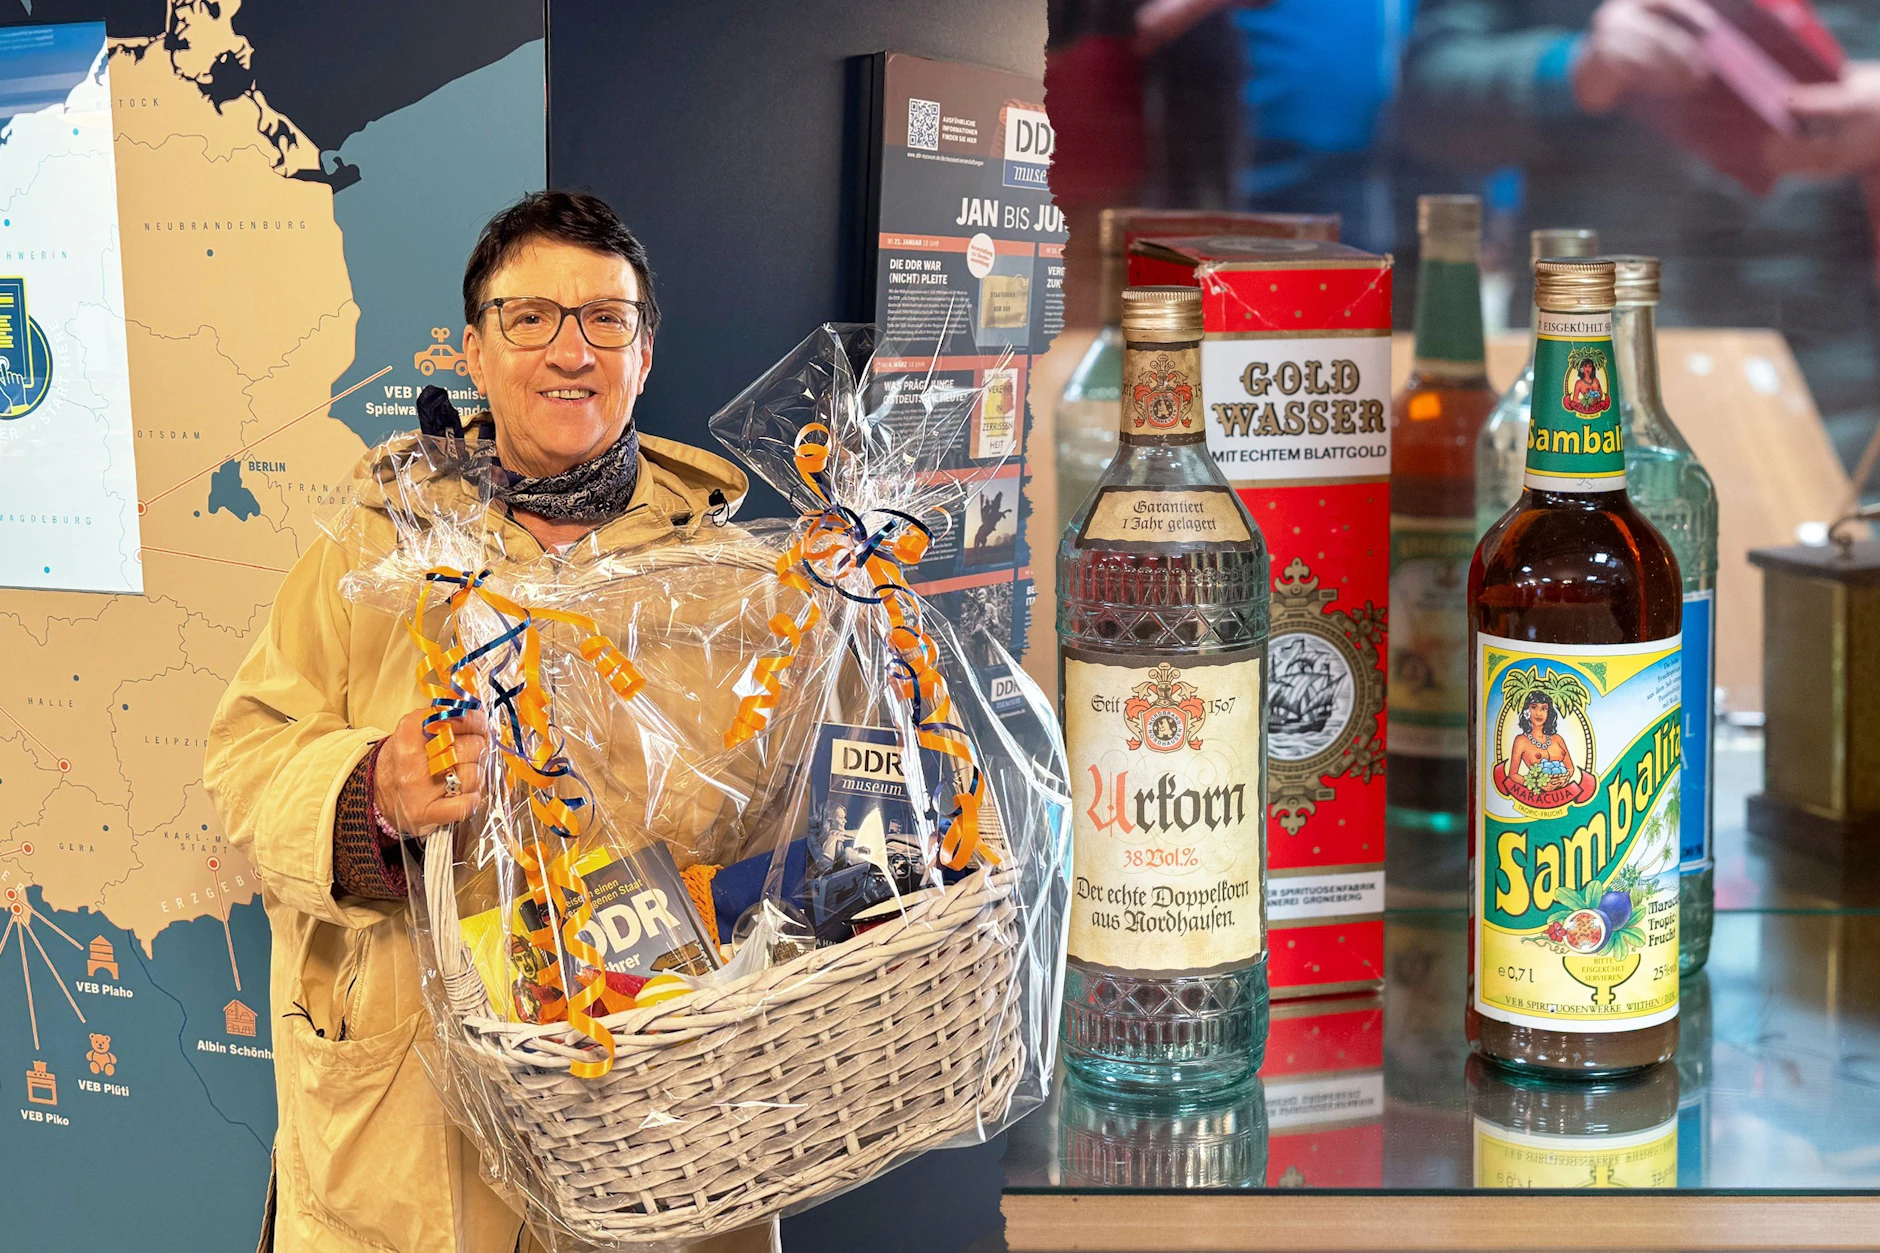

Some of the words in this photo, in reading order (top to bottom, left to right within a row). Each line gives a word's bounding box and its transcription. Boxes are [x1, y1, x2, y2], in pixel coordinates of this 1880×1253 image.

[955, 197, 999, 228] JAN
[1004, 205, 1030, 230] BIS
[144, 221, 306, 231] NEUBRANDENBURG
[889, 258, 904, 270] DIE
[905, 259, 922, 271] DDR
[923, 260, 942, 271] WAR
[889, 272, 920, 285] (NICHT)
[921, 273, 948, 285] PLEITE
[1543, 321, 1604, 333] EISGEKÜHLT
[903, 378, 926, 391] PRÄG
[1240, 359, 1361, 396] GOLD
[383, 385, 413, 399] VEB
[365, 401, 418, 418] Spielwa
[1210, 399, 1387, 438] WASSER
[1211, 450, 1239, 463] MIT
[1240, 448, 1301, 462] ECHTEM
[1304, 445, 1387, 461] BLATTGOLD
[249, 461, 286, 473] BERLIN
[1132, 500, 1204, 516] Garantiert
[1130, 516, 1164, 532] Jahr
[1167, 516, 1217, 533] gelagert
[28, 697, 73, 708] HALLE
[1091, 694, 1121, 714] Seit
[1208, 696, 1237, 716] 1507
[1148, 711, 1182, 727] NORDBRAND
[1148, 727, 1183, 747] NORDHAUSEN
[843, 746, 905, 777] DDR
[841, 778, 906, 797] museum
[1510, 784, 1574, 804] MARACUJA
[1086, 763, 1247, 838] Urkorn
[164, 831, 230, 844] KARL-M
[59, 842, 94, 853] GERA
[181, 843, 228, 854] STADT
[595, 879, 619, 896] einen
[618, 879, 644, 896] Staat
[1076, 876, 1104, 903] Der
[1107, 884, 1147, 910] echte
[1151, 879, 1250, 911] Doppelkorn
[1092, 911, 1120, 930] aus
[1581, 965, 1625, 973] EISGEKÜHLT
[1584, 974, 1623, 982] SERVIEREN
[76, 981, 100, 994] VEB
[102, 984, 134, 998] Plaho
[1505, 995, 1524, 1007] VEB
[1626, 997, 1660, 1011] WILTHEN
[197, 1039, 227, 1053] Albin
[77, 1079, 101, 1092] VEB
[104, 1083, 130, 1097] Plüti
[20, 1109, 43, 1122] VEB
[46, 1112, 70, 1126] Piko
